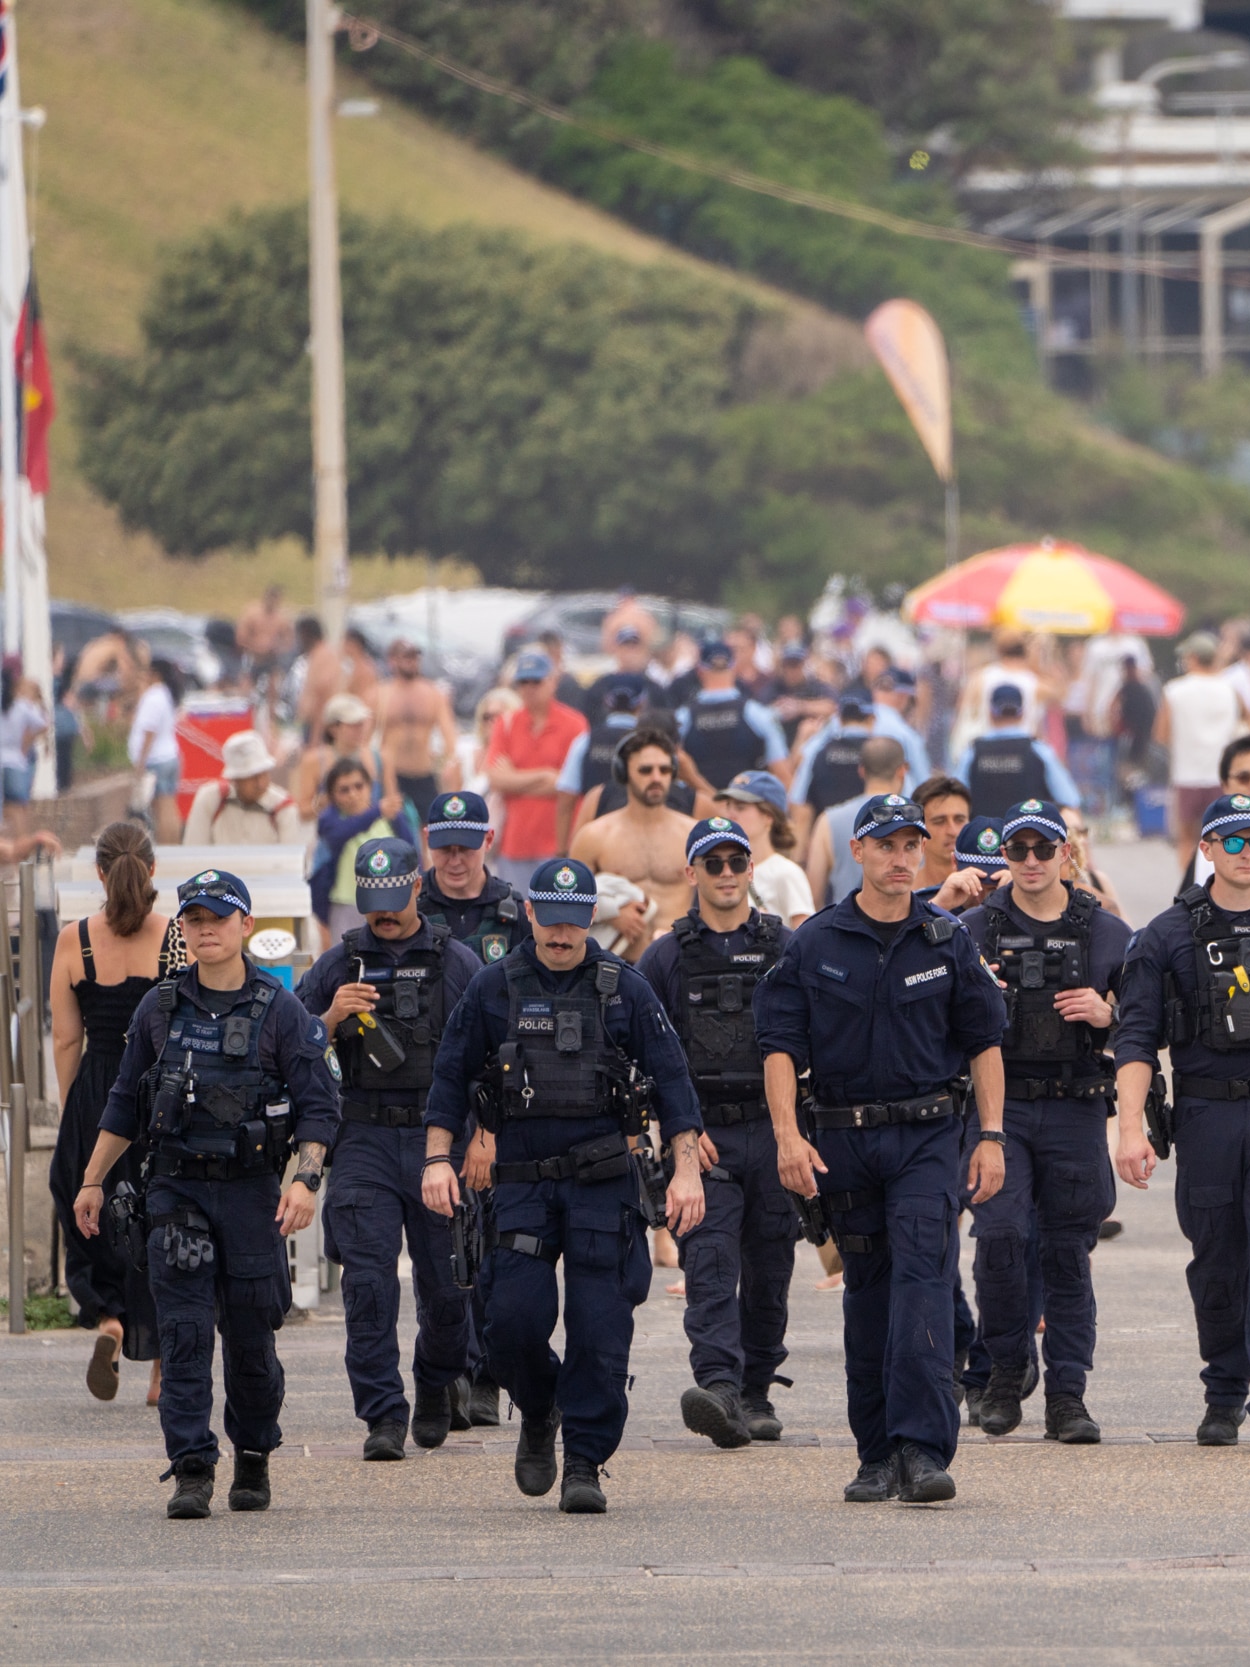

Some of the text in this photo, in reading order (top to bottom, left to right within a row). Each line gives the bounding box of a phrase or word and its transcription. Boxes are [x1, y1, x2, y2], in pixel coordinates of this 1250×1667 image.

[396, 968, 426, 977] POLICE
[904, 965, 948, 987] NSW POLICE FORCE
[518, 1020, 554, 1031] POLICE
